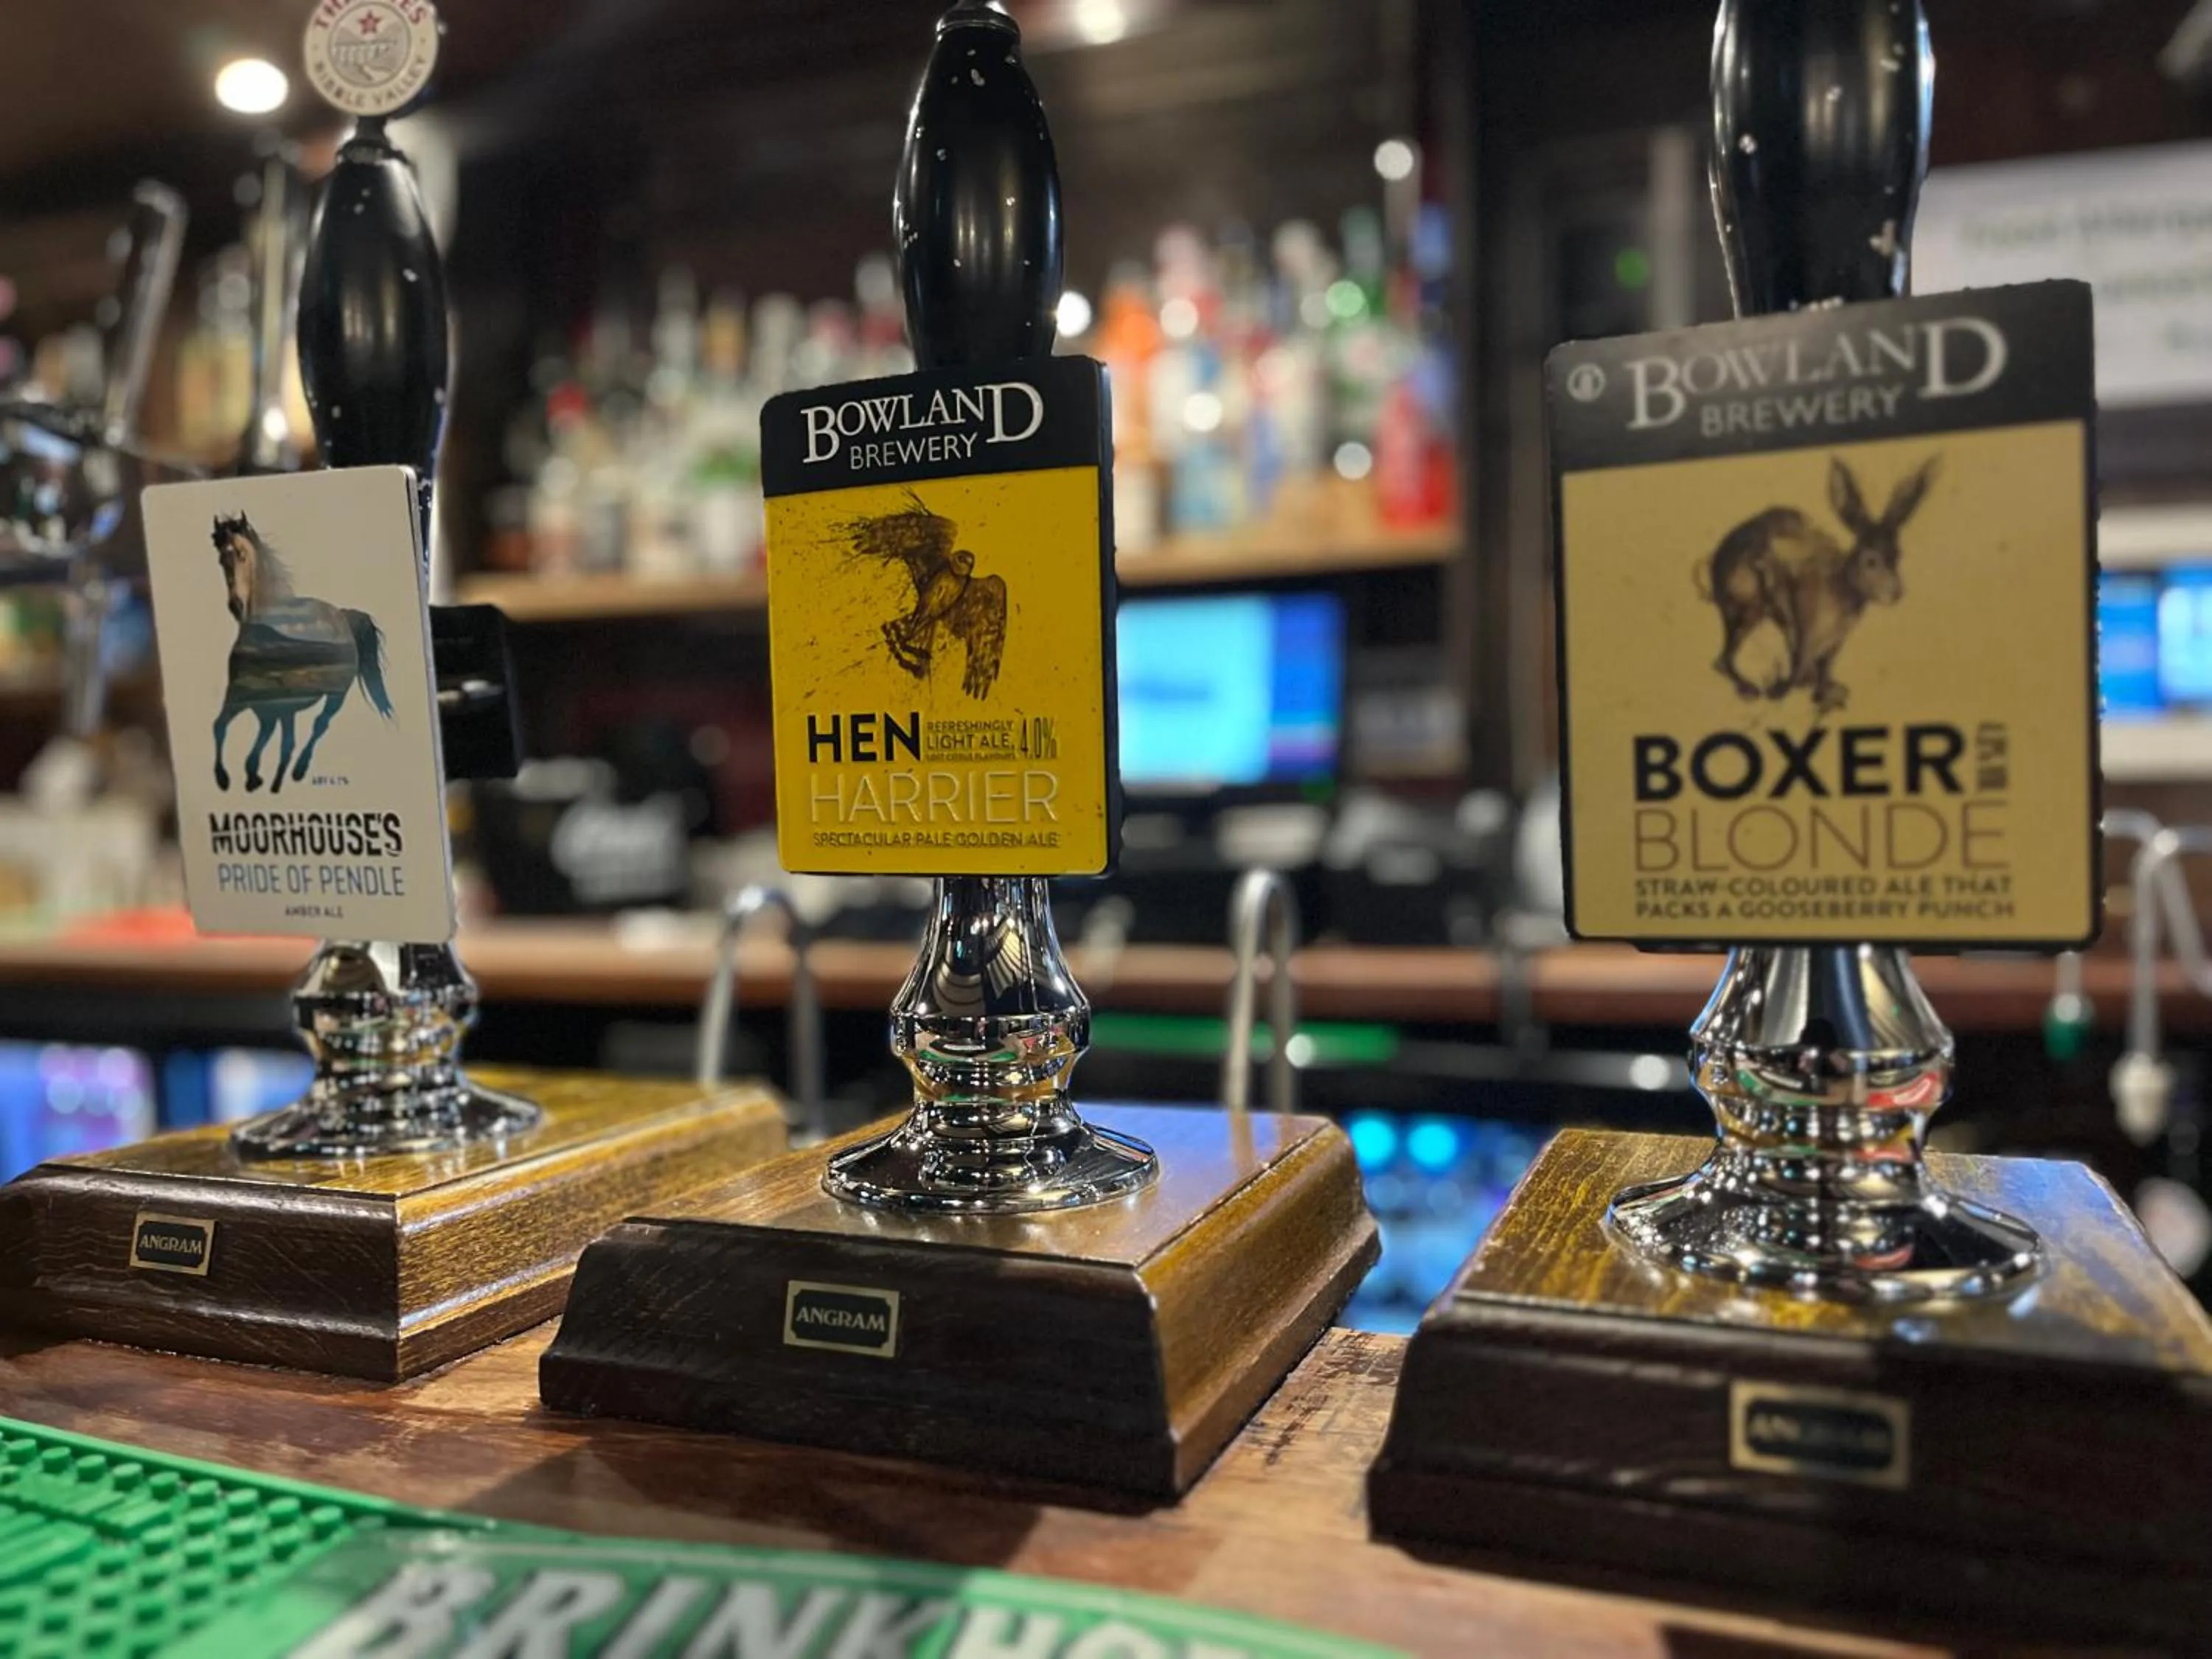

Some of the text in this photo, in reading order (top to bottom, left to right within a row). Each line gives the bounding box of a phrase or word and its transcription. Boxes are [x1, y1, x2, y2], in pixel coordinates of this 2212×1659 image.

[1626, 318, 2007, 431] BOWLAND
[801, 381, 1044, 463] BOWLAND
[1700, 384, 1905, 437] BREWERY
[850, 432, 978, 470] BREWERY
[807, 712, 921, 763] HEN
[927, 720, 1014, 731] REFRESHINGLY
[927, 734, 974, 749] LIGHT
[1632, 721, 1966, 802] BOXER
[810, 771, 1059, 824] HARRIER
[209, 813, 403, 857] MOORHOUSE'S
[813, 831, 1059, 847] SPECTACULAR PALE GOLDEN ALE
[1633, 800, 2010, 872] BLONDE
[218, 863, 405, 896] PRIDE OF PENDLE
[1885, 876, 1933, 895] ALE
[1944, 876, 2012, 894] THAT
[1635, 900, 2014, 919] PACKS A GOOSEBERRY PUNCH
[139, 1234, 202, 1254] ANGRAM
[796, 1307, 885, 1332] ANGRAM
